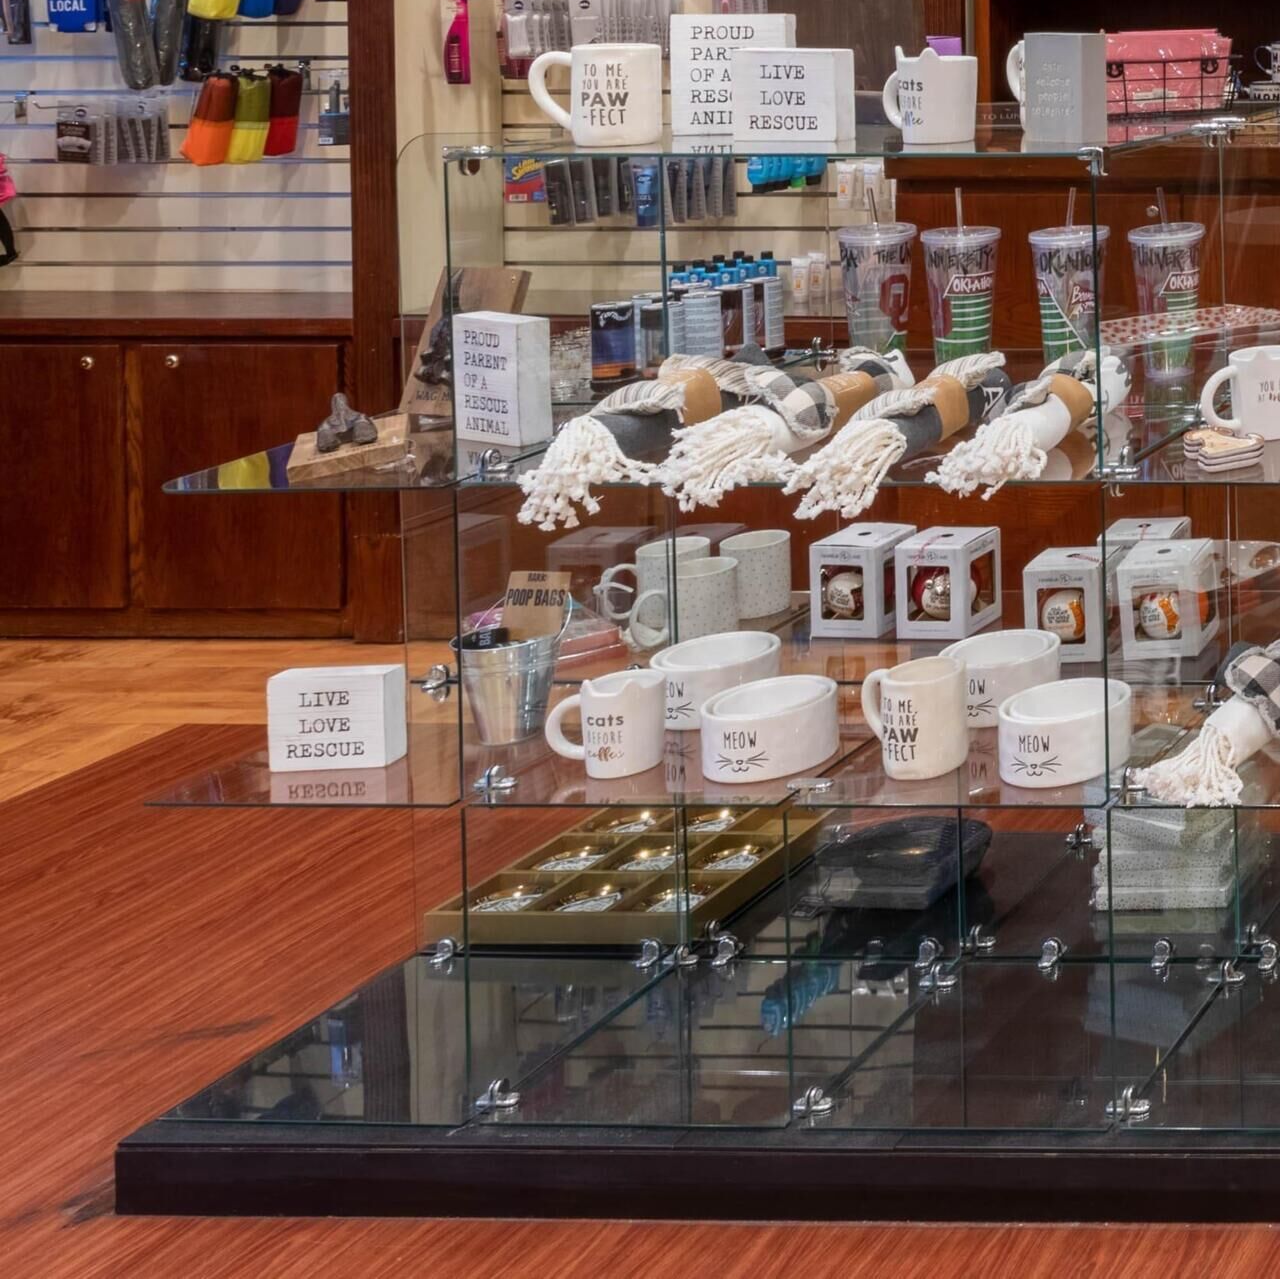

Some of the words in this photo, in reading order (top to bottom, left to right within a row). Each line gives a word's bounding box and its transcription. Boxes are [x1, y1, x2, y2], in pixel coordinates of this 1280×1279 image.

[49, 0, 87, 12] LOCAL
[690, 25, 755, 40] PROUD
[584, 64, 597, 77] TO
[690, 68, 715, 82] OF
[721, 68, 732, 82] A
[760, 65, 805, 80] LIVE
[582, 78, 598, 90] YOU
[606, 78, 628, 90] ARE
[581, 92, 629, 107] PAW
[760, 91, 806, 106] LOVE
[749, 115, 818, 130] RESCUE
[464, 329, 500, 348] PROUD
[464, 351, 508, 371] PARENT
[464, 372, 478, 389] OF
[481, 375, 488, 390] A
[1259, 380, 1275, 393] YOU
[416, 390, 438, 401] WAG
[464, 395, 509, 414] RESCUE
[465, 417, 510, 436] ANIMAL
[506, 588, 534, 606] POOP
[534, 588, 565, 606] BAGS
[970, 679, 986, 695] OW
[298, 690, 350, 708] LIVE
[298, 717, 351, 734] LOVE
[586, 714, 624, 727] cats
[899, 715, 916, 727] ARE
[723, 731, 757, 750] MEOW
[882, 727, 919, 743] PAW
[286, 741, 365, 759] RESCUE
[1019, 735, 1050, 753] MEOW
